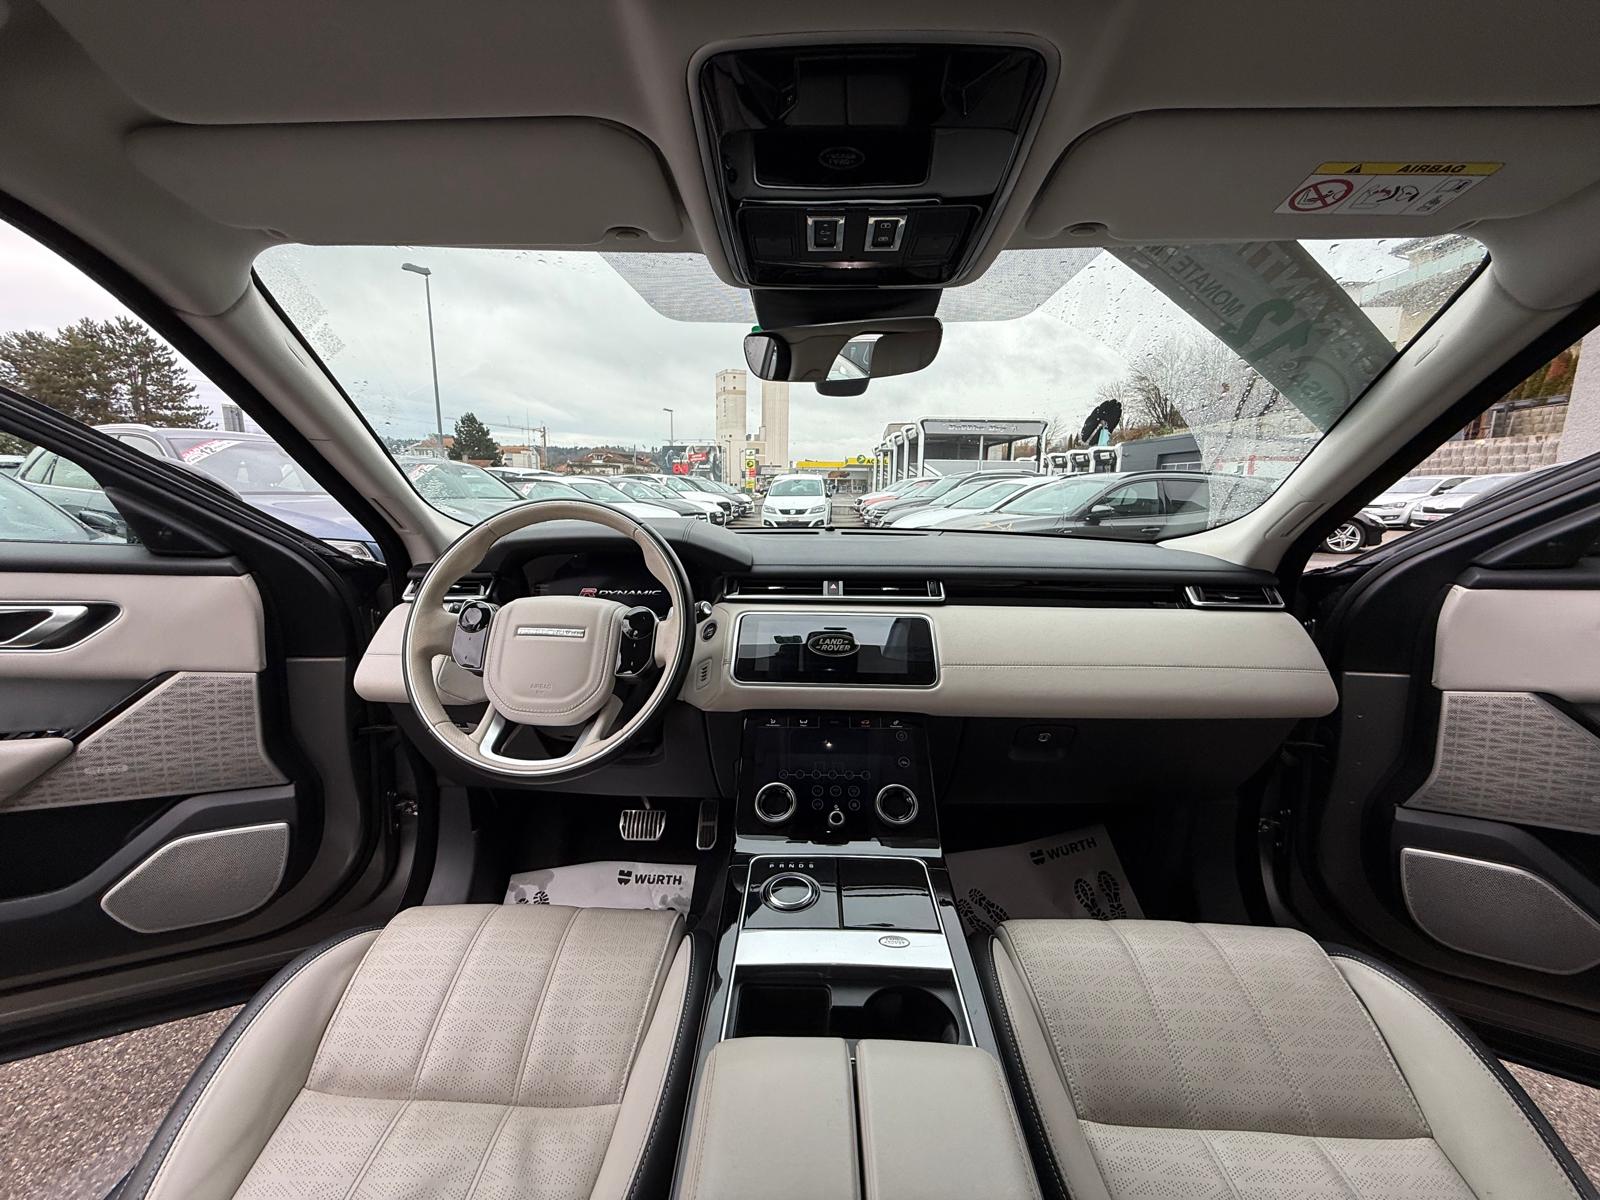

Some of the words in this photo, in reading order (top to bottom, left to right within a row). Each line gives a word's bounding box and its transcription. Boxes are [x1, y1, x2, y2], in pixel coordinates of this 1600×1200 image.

[1396, 164, 1468, 174] AIRBAG
[598, 589, 662, 597] DYNAMIC
[634, 873, 683, 886] WÜRTH
